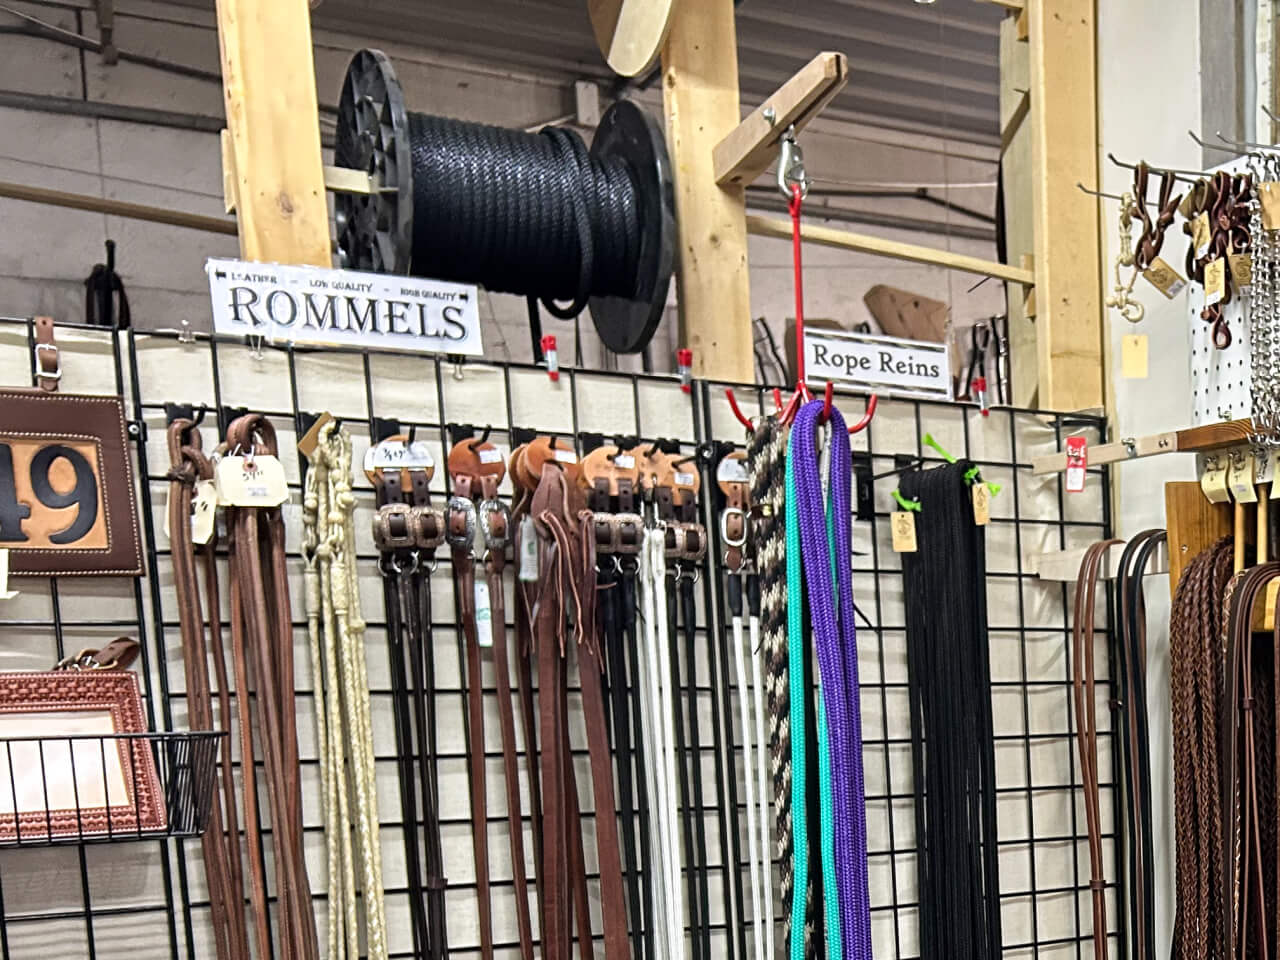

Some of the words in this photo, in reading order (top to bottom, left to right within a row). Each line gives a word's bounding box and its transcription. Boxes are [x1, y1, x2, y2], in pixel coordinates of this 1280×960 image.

[309, 279, 329, 289] LOW
[332, 281, 374, 293] QUALITY
[228, 285, 469, 342] ROMMELS
[812, 343, 872, 376] Rope
[879, 350, 941, 378] Reins
